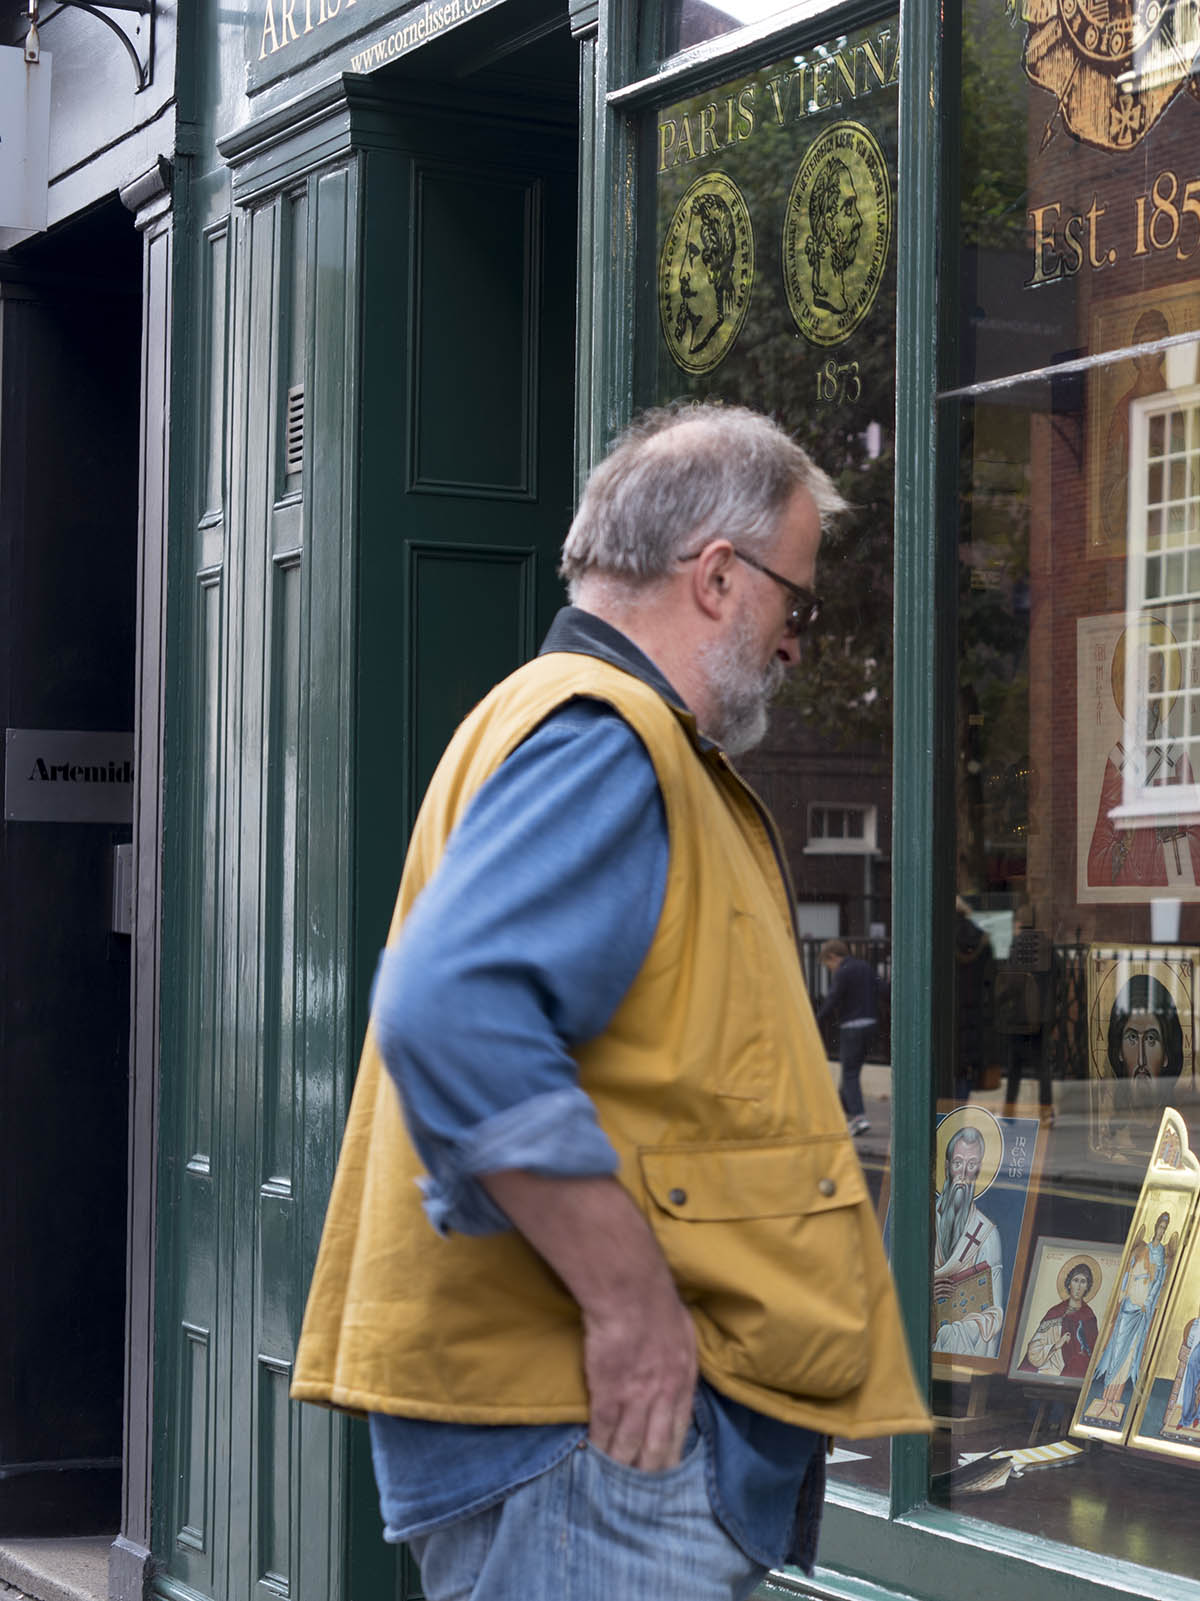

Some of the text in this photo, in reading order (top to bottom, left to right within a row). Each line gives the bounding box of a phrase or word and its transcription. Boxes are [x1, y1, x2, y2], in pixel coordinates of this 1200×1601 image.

[258, 0, 358, 61] ART
[658, 84, 757, 173] PARIS
[1024, 191, 1118, 289] Est.
[816, 360, 861, 404] 1873
